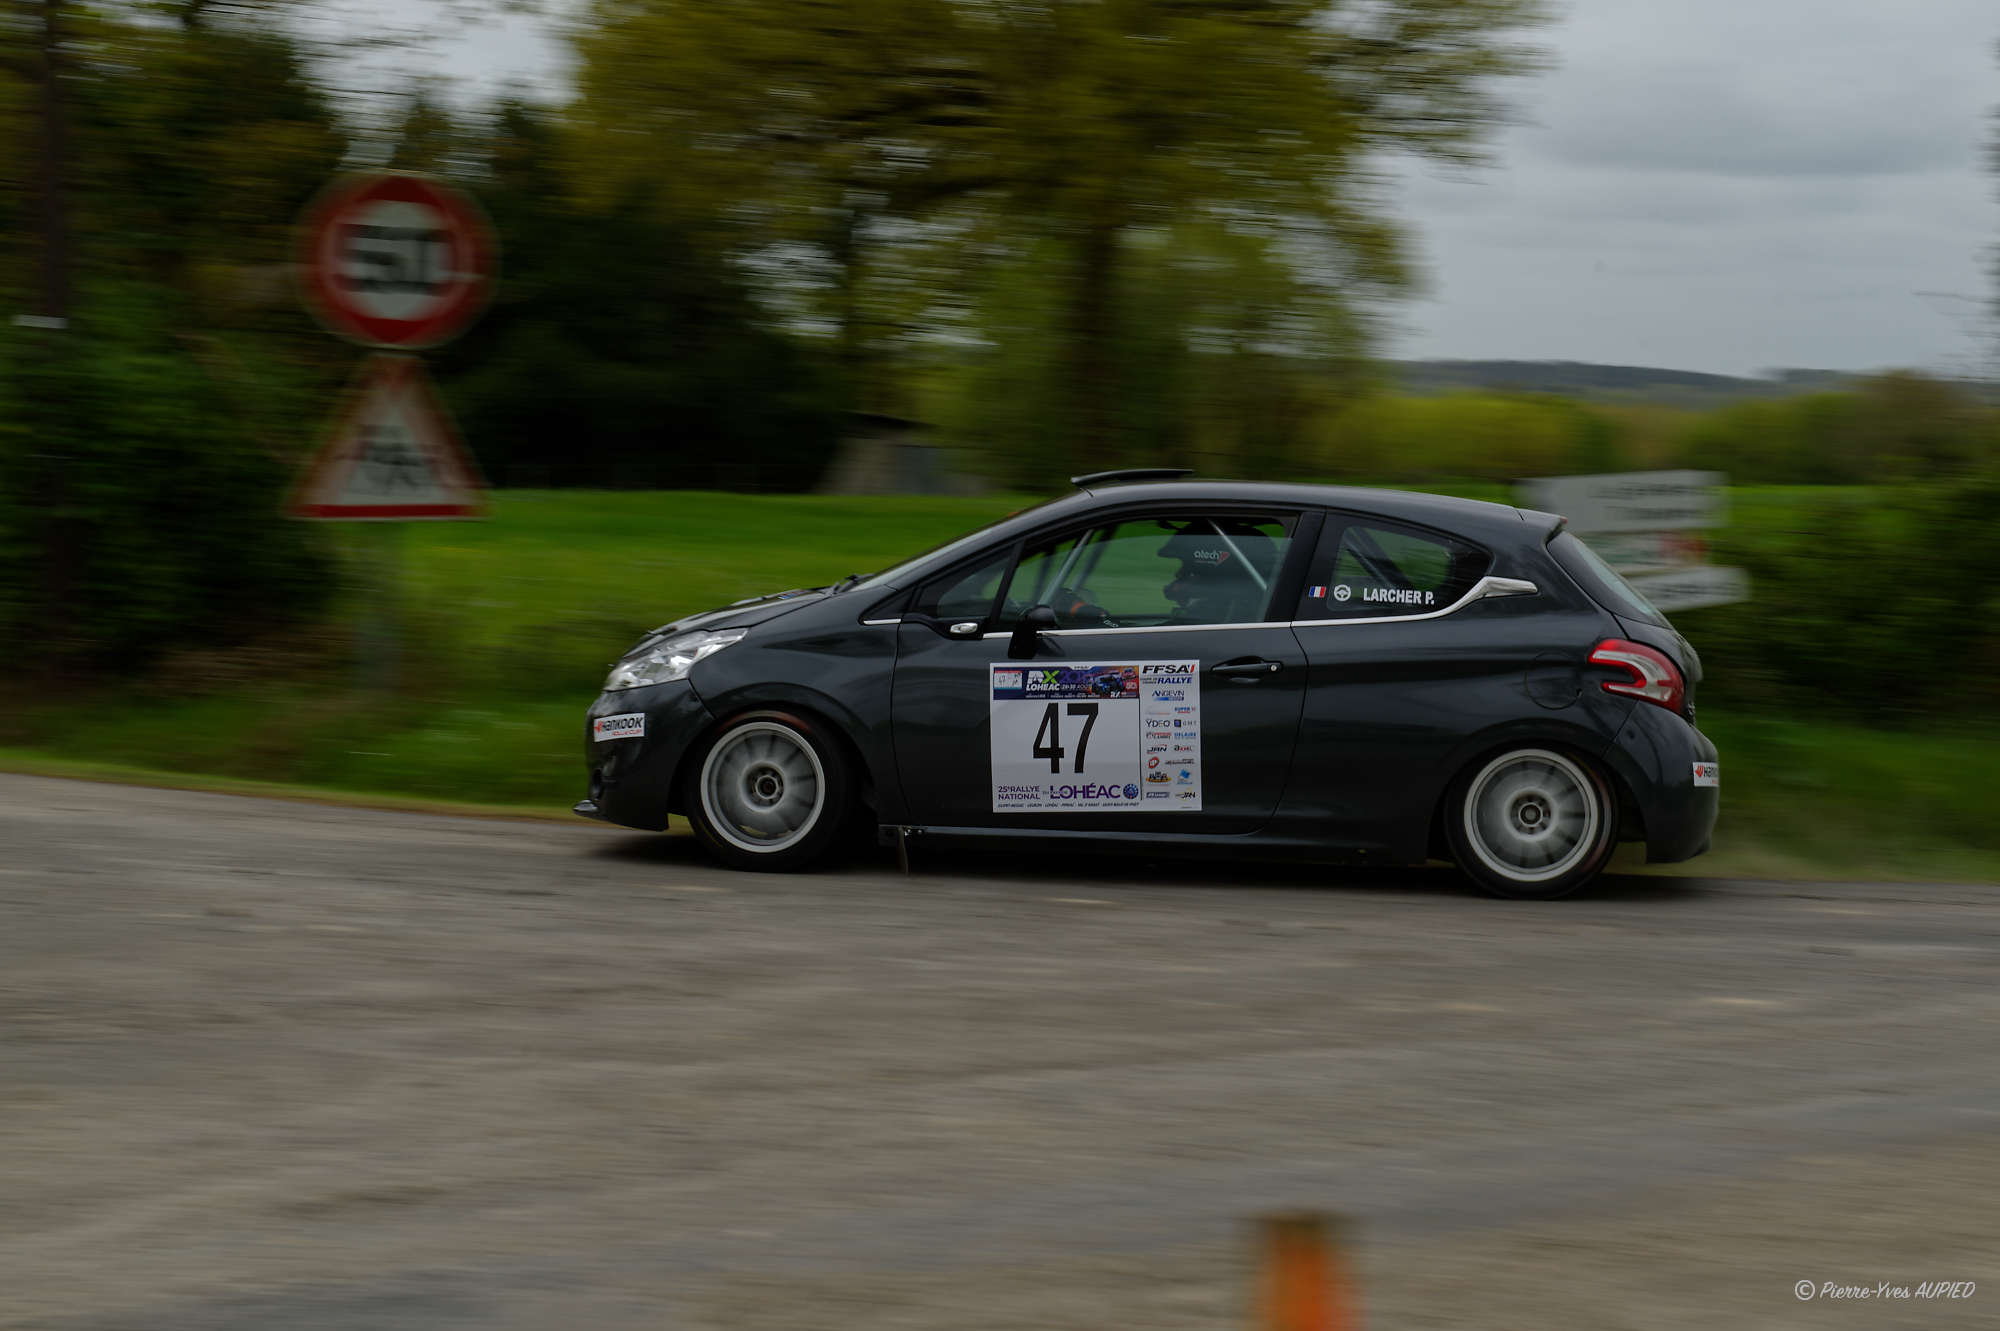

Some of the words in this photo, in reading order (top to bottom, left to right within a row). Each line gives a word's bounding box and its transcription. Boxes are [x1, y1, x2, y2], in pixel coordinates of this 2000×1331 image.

[1363, 587, 1422, 605] LARCHER
[1425, 591, 1435, 605] P.
[1142, 664, 1189, 674] FFSA
[1157, 677, 1193, 685] RALLYE
[1033, 702, 1099, 774] 47
[1050, 782, 1121, 800] LOHÉAC
